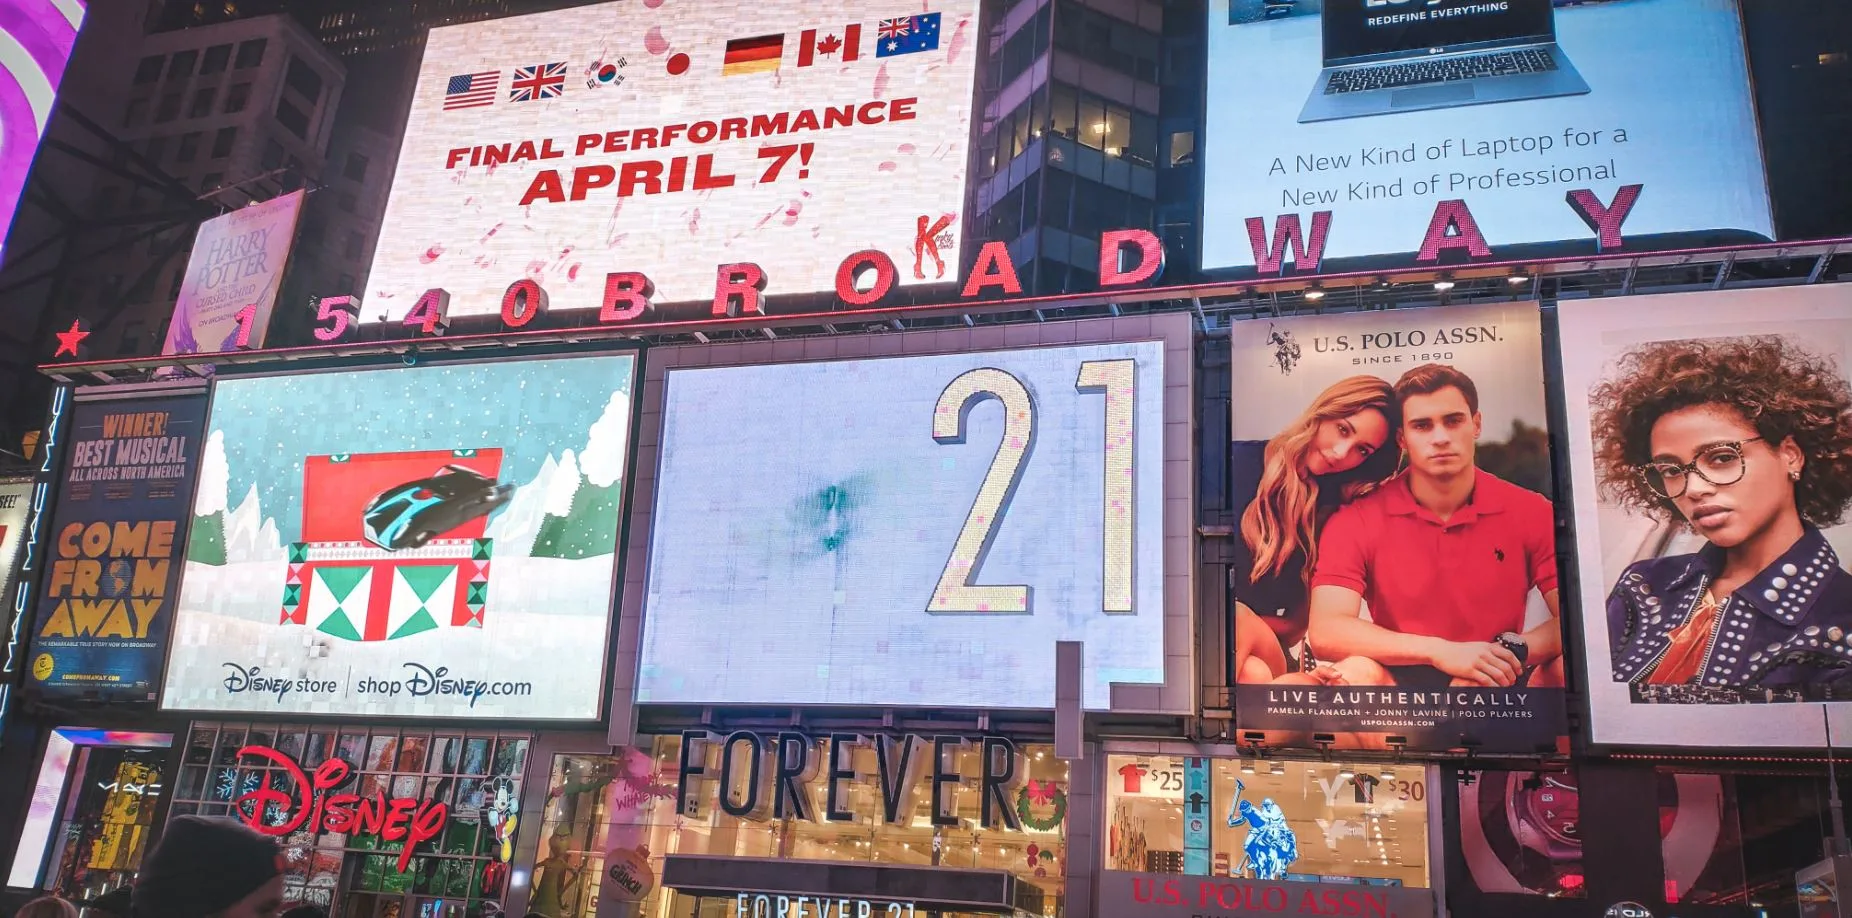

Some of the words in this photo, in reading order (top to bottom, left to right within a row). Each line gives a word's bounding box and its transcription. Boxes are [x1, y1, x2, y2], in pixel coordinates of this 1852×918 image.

[1368, 11, 1426, 26] REDEFINE
[1431, 2, 1509, 18] EVERYTHING
[446, 139, 564, 169] FINAL
[575, 97, 918, 156] PERFORMANCE
[1269, 157, 1286, 176] A
[1296, 154, 1351, 173] New
[1362, 143, 1415, 167] Kind
[1426, 139, 1452, 160] of
[1462, 134, 1553, 159] Laptop
[1563, 128, 1603, 148] for
[1613, 128, 1629, 143] a
[519, 153, 736, 205] APRIL
[757, 142, 815, 184] 7!
[1283, 188, 1338, 208] New
[1349, 177, 1402, 201] Kind
[1413, 174, 1440, 195] of
[1450, 159, 1616, 192] Professional
[206, 223, 276, 265] HARRY
[192, 251, 268, 297] POTTER
[1313, 335, 1354, 353] U.S.
[1361, 330, 1426, 350] POLO
[1433, 326, 1504, 346] ASSN.
[1352, 355, 1402, 366] SINCE
[1411, 351, 1453, 362] 1890
[103, 411, 169, 439] WINNER!
[73, 440, 114, 468] BEST
[115, 436, 187, 466] MUSICAL
[69, 469, 84, 482] ALL
[86, 467, 119, 481] ACROSS
[120, 466, 146, 480] NORTH
[147, 464, 185, 480] AMERICA
[926, 357, 1138, 617] 21
[59, 520, 176, 559] COME
[49, 559, 171, 598] FROM
[39, 598, 163, 639] AWAY
[222, 662, 293, 704] Disney
[296, 678, 337, 693] store
[357, 676, 402, 697] shop
[1269, 690, 1318, 703] LIVE
[1332, 692, 1527, 706] AUTHENTICALLY
[1267, 707, 1305, 715] PAMELA
[1308, 708, 1360, 716] FLANAGAN
[1374, 708, 1408, 717] JONNY
[1412, 709, 1448, 717] LAVINE
[1459, 710, 1486, 718] POLO
[1490, 710, 1533, 718] PLAYERS
[676, 728, 1029, 835] FOREVER
[1151, 769, 1183, 791] $25
[1389, 780, 1425, 801] $30
[236, 745, 447, 874] Disney
[737, 893, 871, 918] FOREVER
[1132, 876, 1189, 906] U.S.
[1200, 881, 1288, 912] POLO
[1298, 888, 1398, 918] ASSN.
